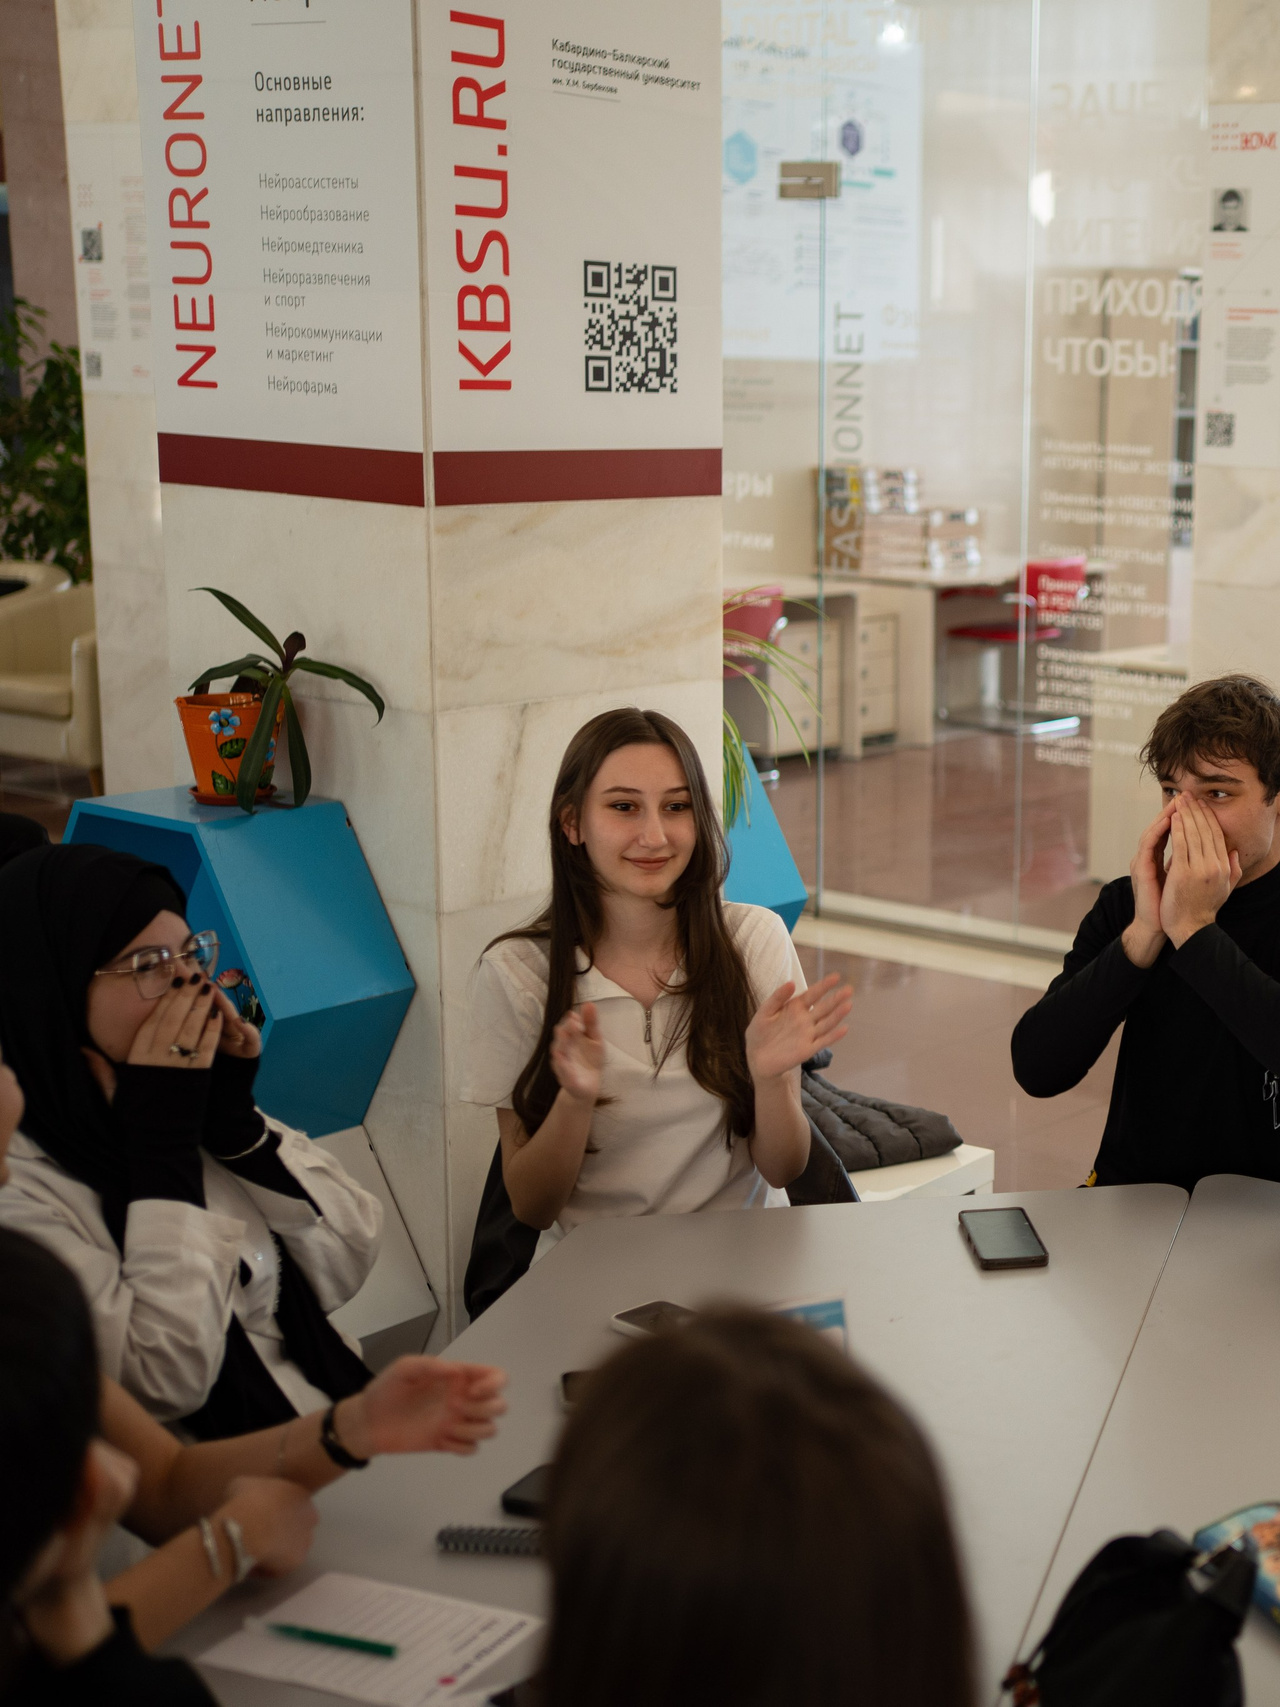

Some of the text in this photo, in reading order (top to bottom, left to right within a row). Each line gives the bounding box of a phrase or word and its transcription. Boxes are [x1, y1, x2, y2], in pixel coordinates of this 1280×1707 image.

[552, 38, 670, 70] Кабардино-Балкарский
[254, 71, 333, 91] Основные
[552, 57, 701, 91] государственный университет
[256, 106, 365, 127] направления:
[259, 173, 359, 192] Нейроассистенты
[450, 10, 512, 391] KBSU.RU
[260, 205, 370, 224] Нейрообразование
[261, 237, 364, 256] Нейромедтехника
[263, 268, 371, 287] Нейроразвлечения
[264, 294, 306, 309] и спорт
[265, 321, 383, 343] Нейрокоммуникации
[266, 349, 335, 363] и маркетинг
[1042, 336, 1175, 379] ЧТОБЫ:
[267, 375, 338, 395] Нейрофарма
